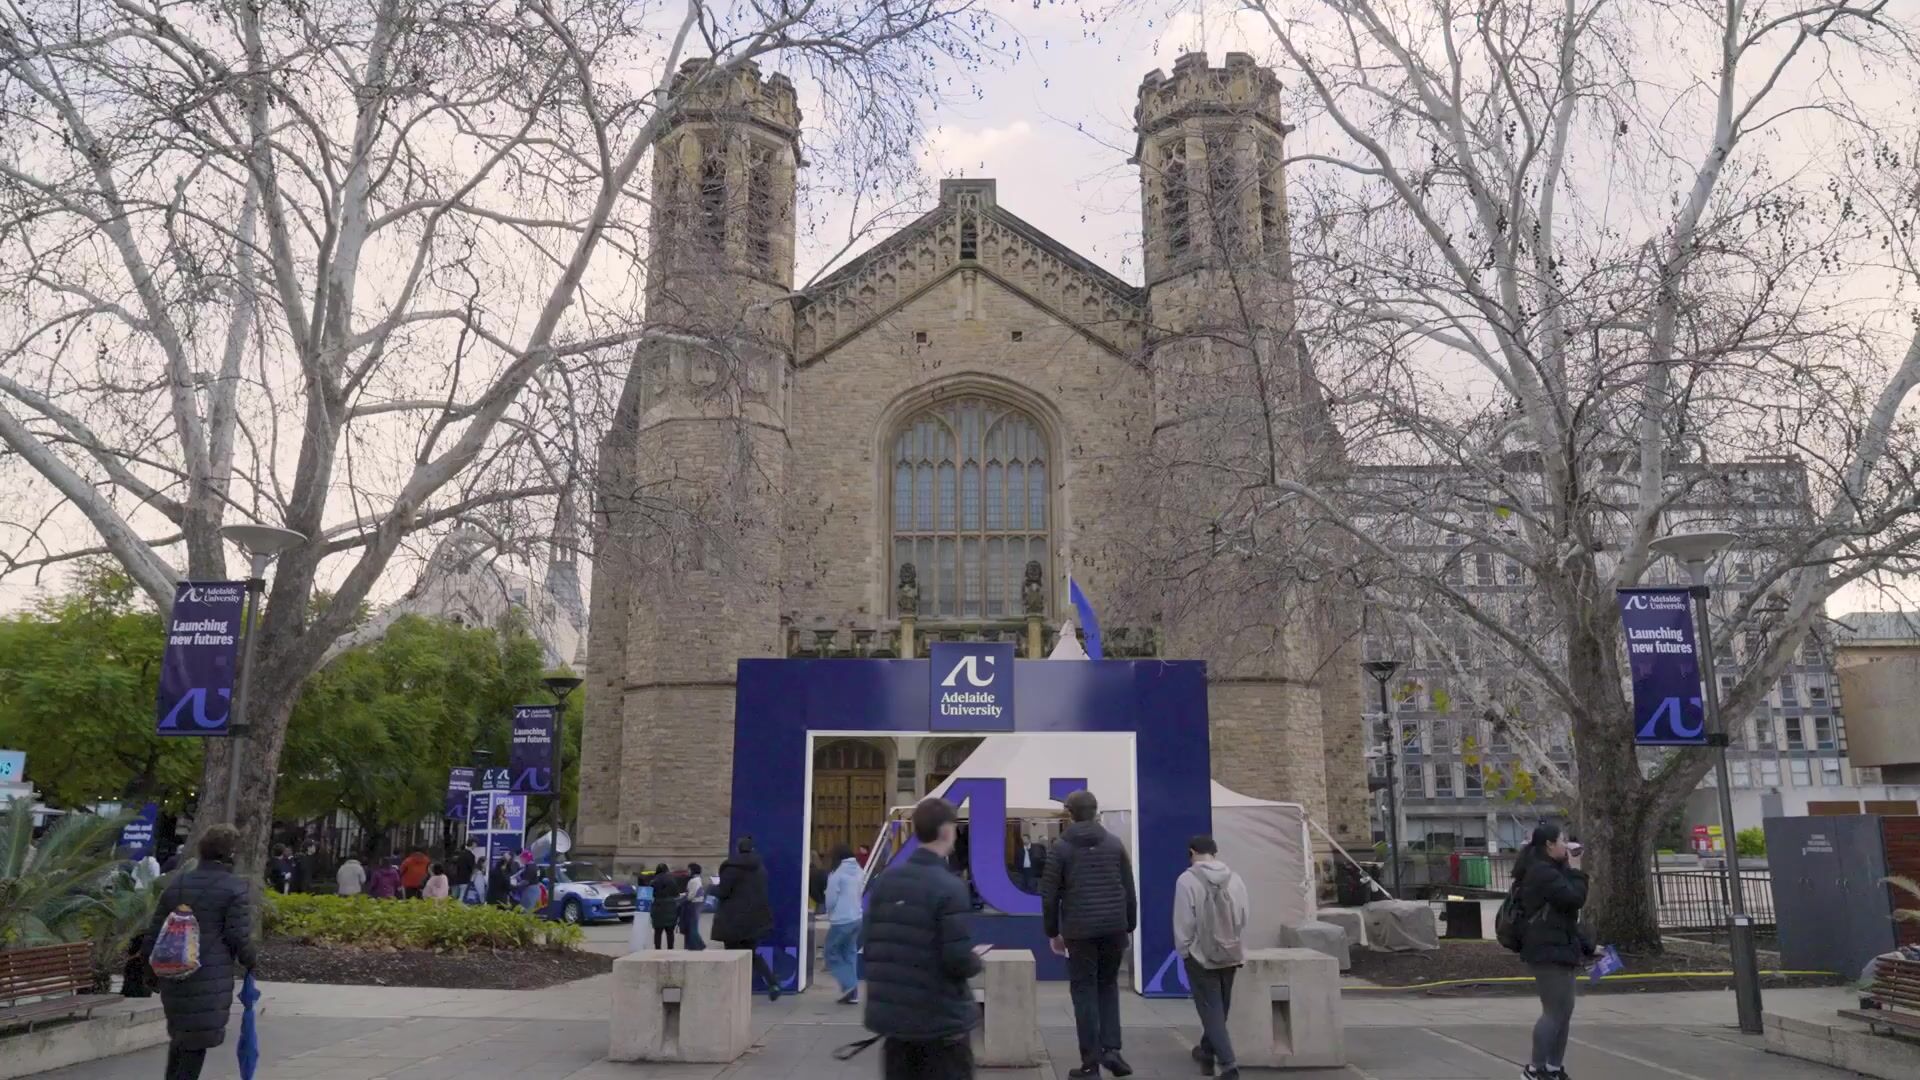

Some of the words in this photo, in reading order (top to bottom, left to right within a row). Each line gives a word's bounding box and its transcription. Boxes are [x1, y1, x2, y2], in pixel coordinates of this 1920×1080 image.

[204, 595, 240, 603] University
[1650, 602, 1686, 611] University
[173, 619, 228, 633] Launching
[170, 635, 192, 645] new
[194, 633, 233, 645] futures
[1628, 627, 1683, 641] Launching
[1632, 643, 1653, 653] new
[1655, 641, 1692, 653] futures
[941, 692, 995, 703] Adelaide
[941, 704, 1002, 718] University
[514, 728, 546, 736] Launching
